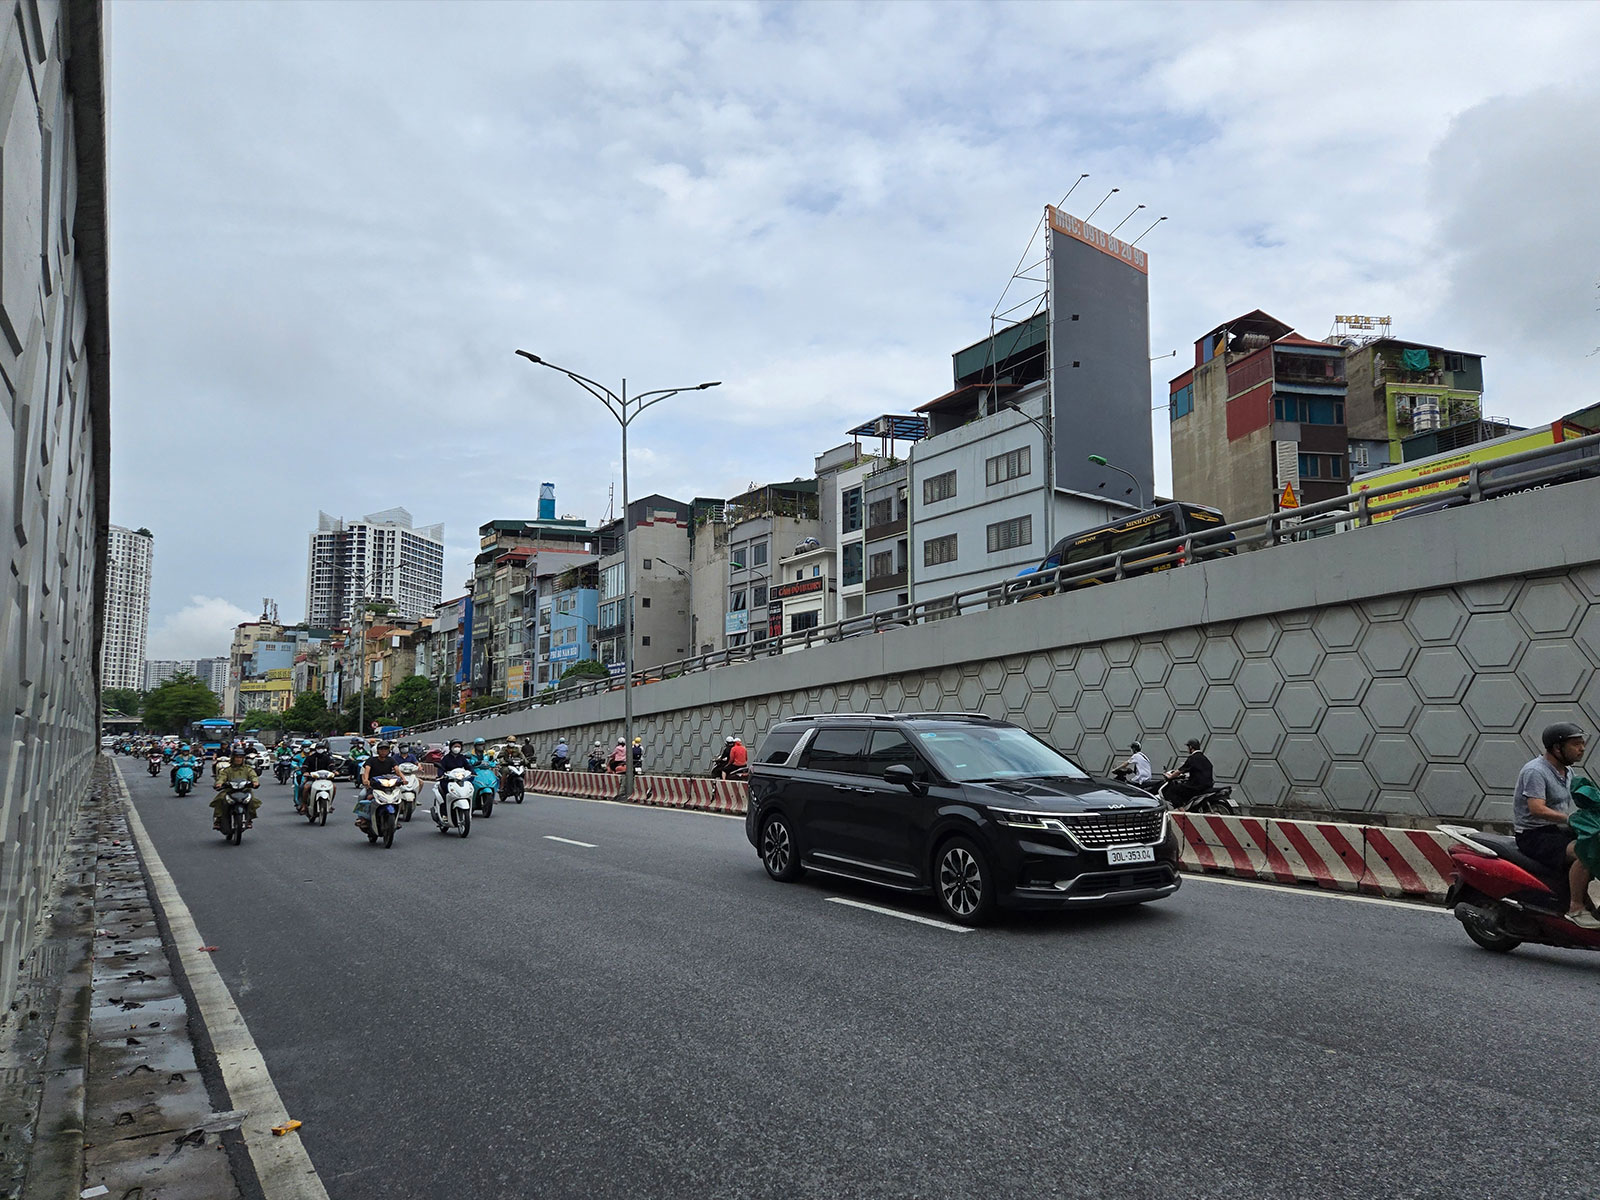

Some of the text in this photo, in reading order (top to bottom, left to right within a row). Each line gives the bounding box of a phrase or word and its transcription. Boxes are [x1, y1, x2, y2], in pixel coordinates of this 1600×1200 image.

[1083, 223, 1106, 248] 0916
[1108, 235, 1119, 254] 80
[1121, 242, 1132, 260] 20
[1134, 249, 1144, 267] 99
[1112, 850, 1151, 862] 30L-353.04
